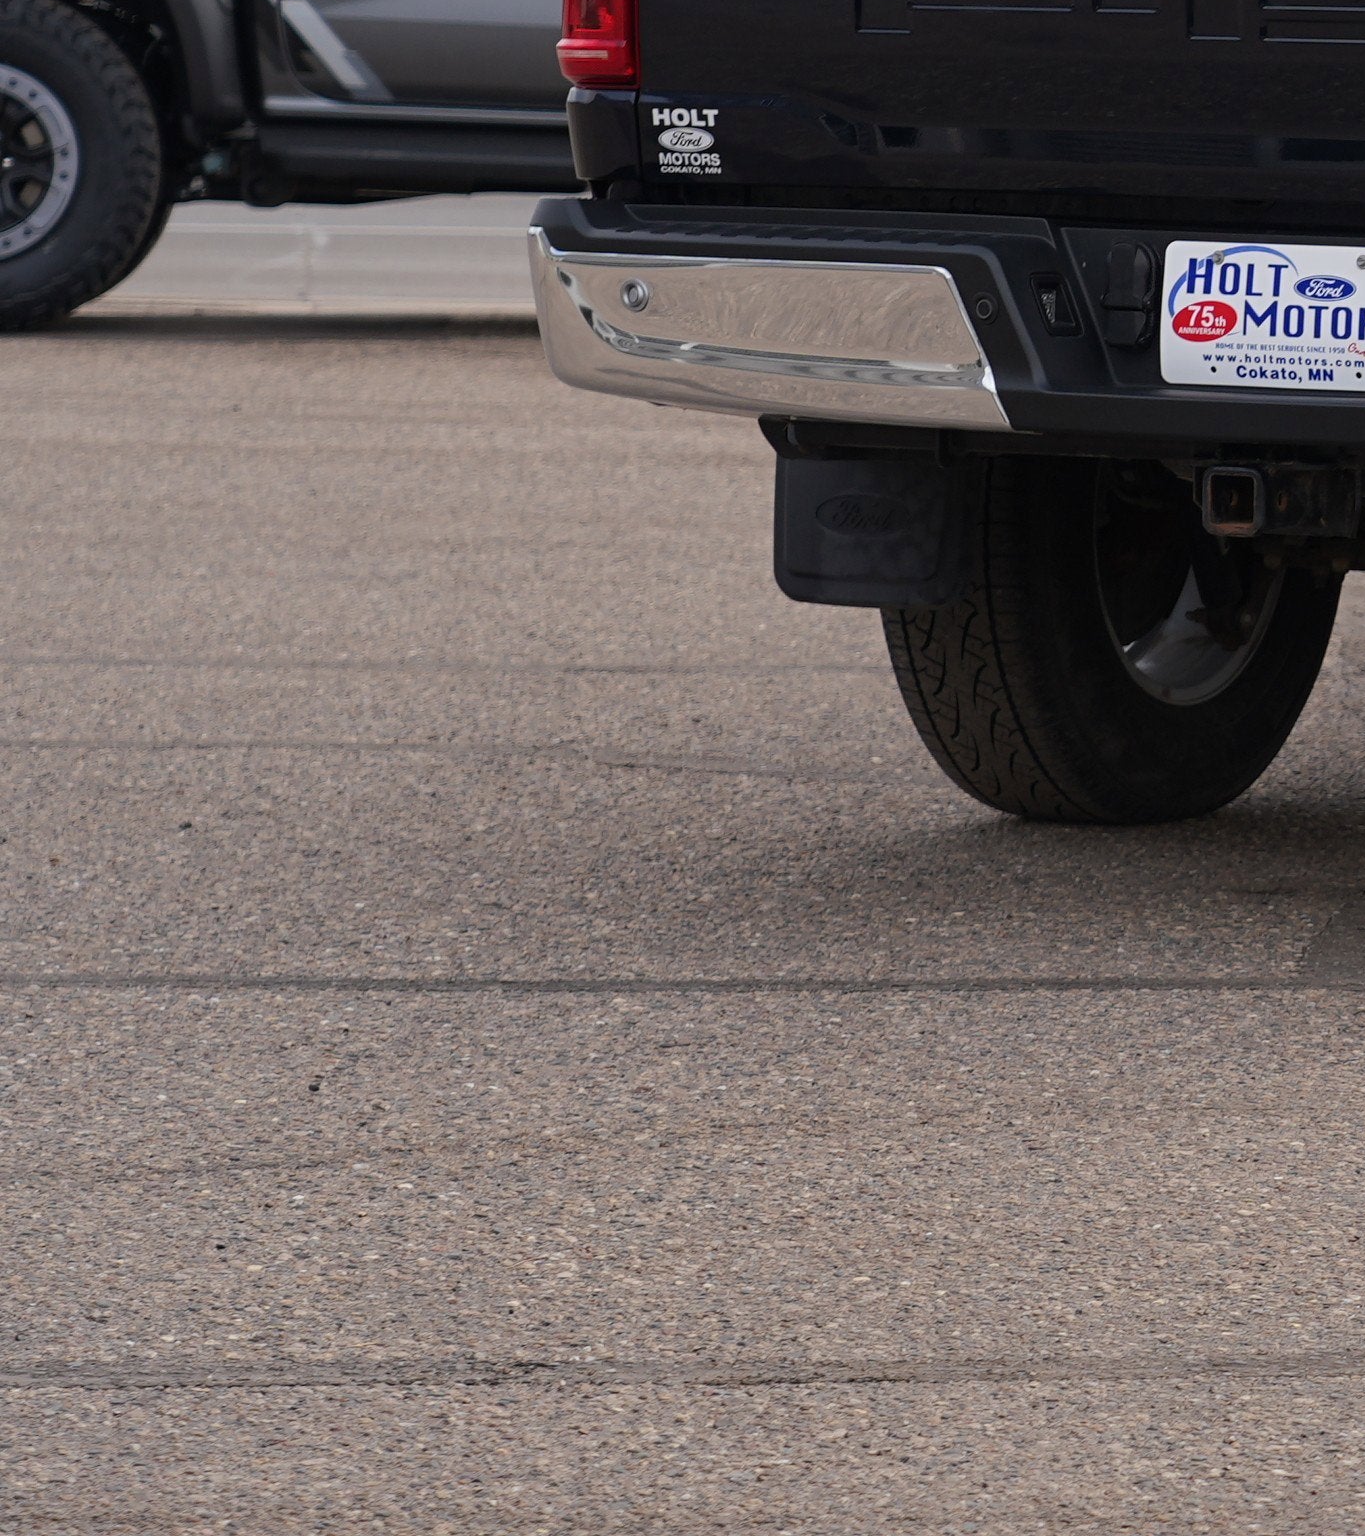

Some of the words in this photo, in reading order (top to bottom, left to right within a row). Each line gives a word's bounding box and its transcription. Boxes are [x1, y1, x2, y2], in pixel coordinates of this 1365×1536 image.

[652, 107, 719, 127] HOLT
[669, 131, 703, 147] Ford
[658, 152, 721, 167] MOTORS
[660, 165, 704, 175] COKATO,
[705, 166, 722, 175] MN
[1186, 257, 1289, 297] HOLT
[1304, 278, 1346, 299] Ford
[1187, 305, 1227, 327] 75th
[1177, 326, 1226, 336] ANNIVERSARY
[1215, 342, 1234, 350] HOME
[1202, 354, 1365, 368] www.holtmotors.com
[1236, 365, 1303, 383] Cokato,
[1308, 368, 1334, 382] MN
